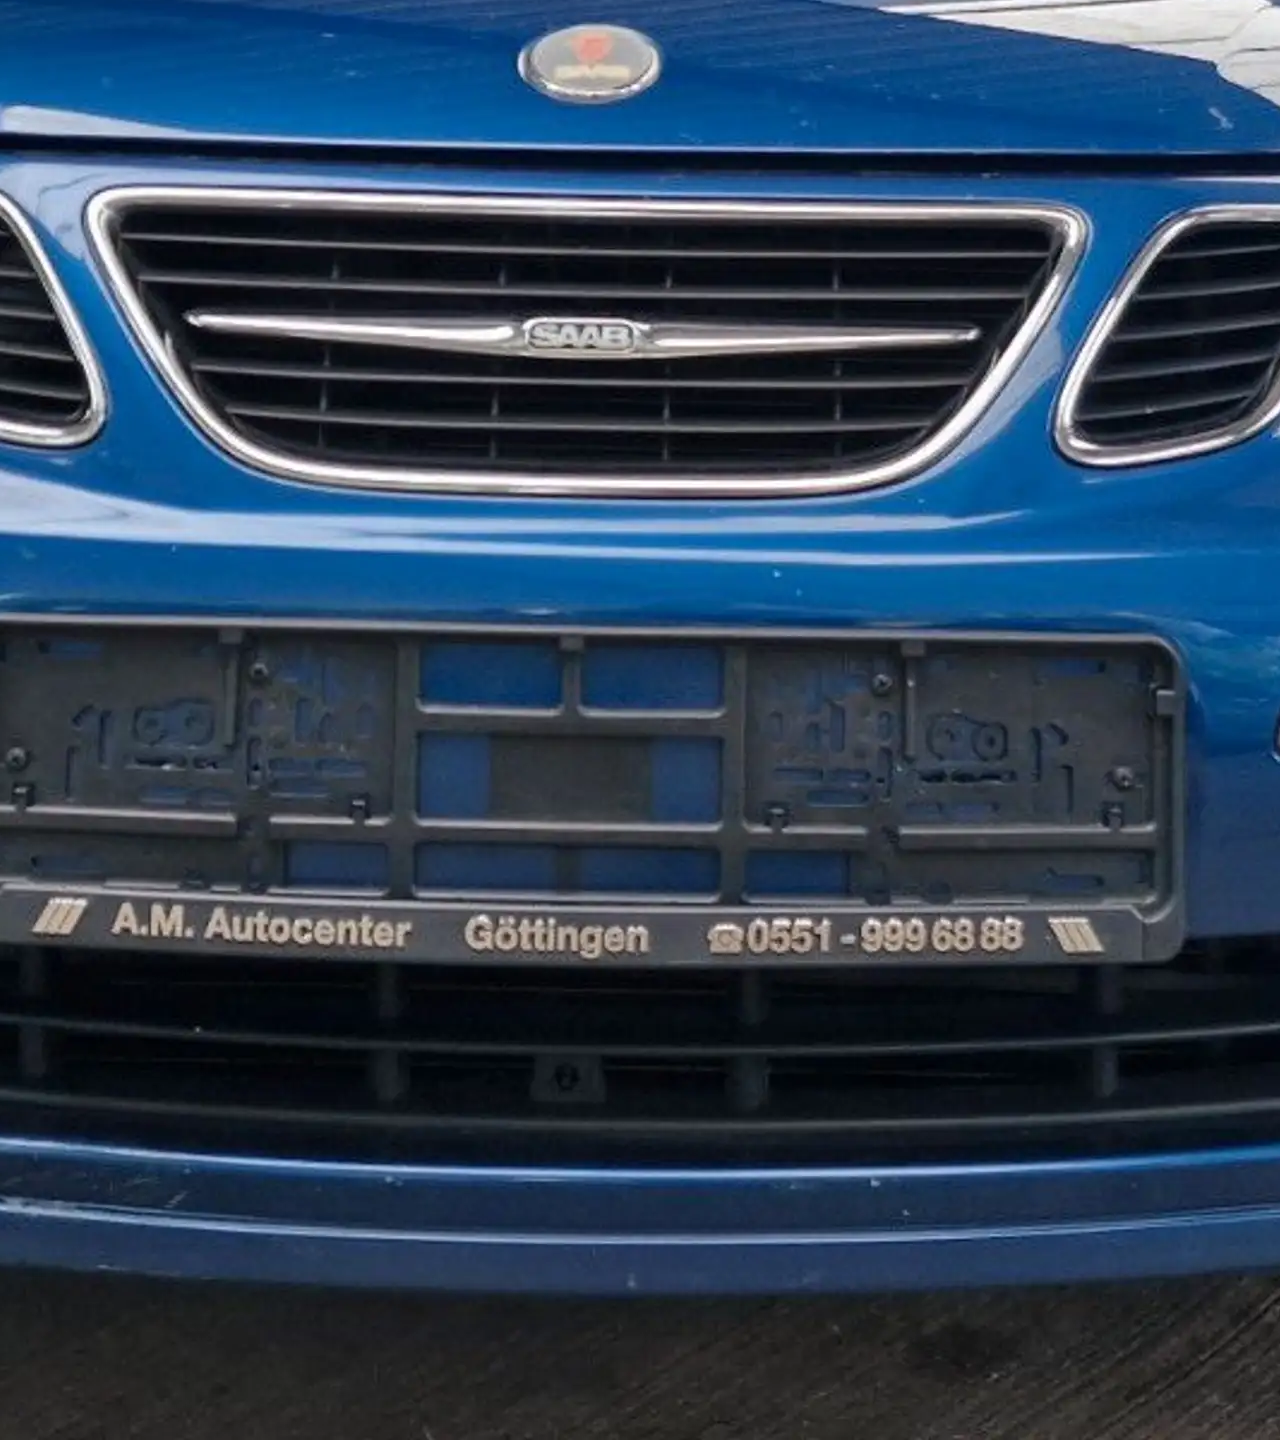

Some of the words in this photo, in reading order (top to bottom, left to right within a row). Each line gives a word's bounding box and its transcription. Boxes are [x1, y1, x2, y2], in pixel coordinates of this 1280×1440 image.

[531, 323, 632, 348] SAAB
[111, 902, 195, 938] A.M.
[204, 905, 412, 948] Autocenter
[464, 912, 650, 956] Göttingen
